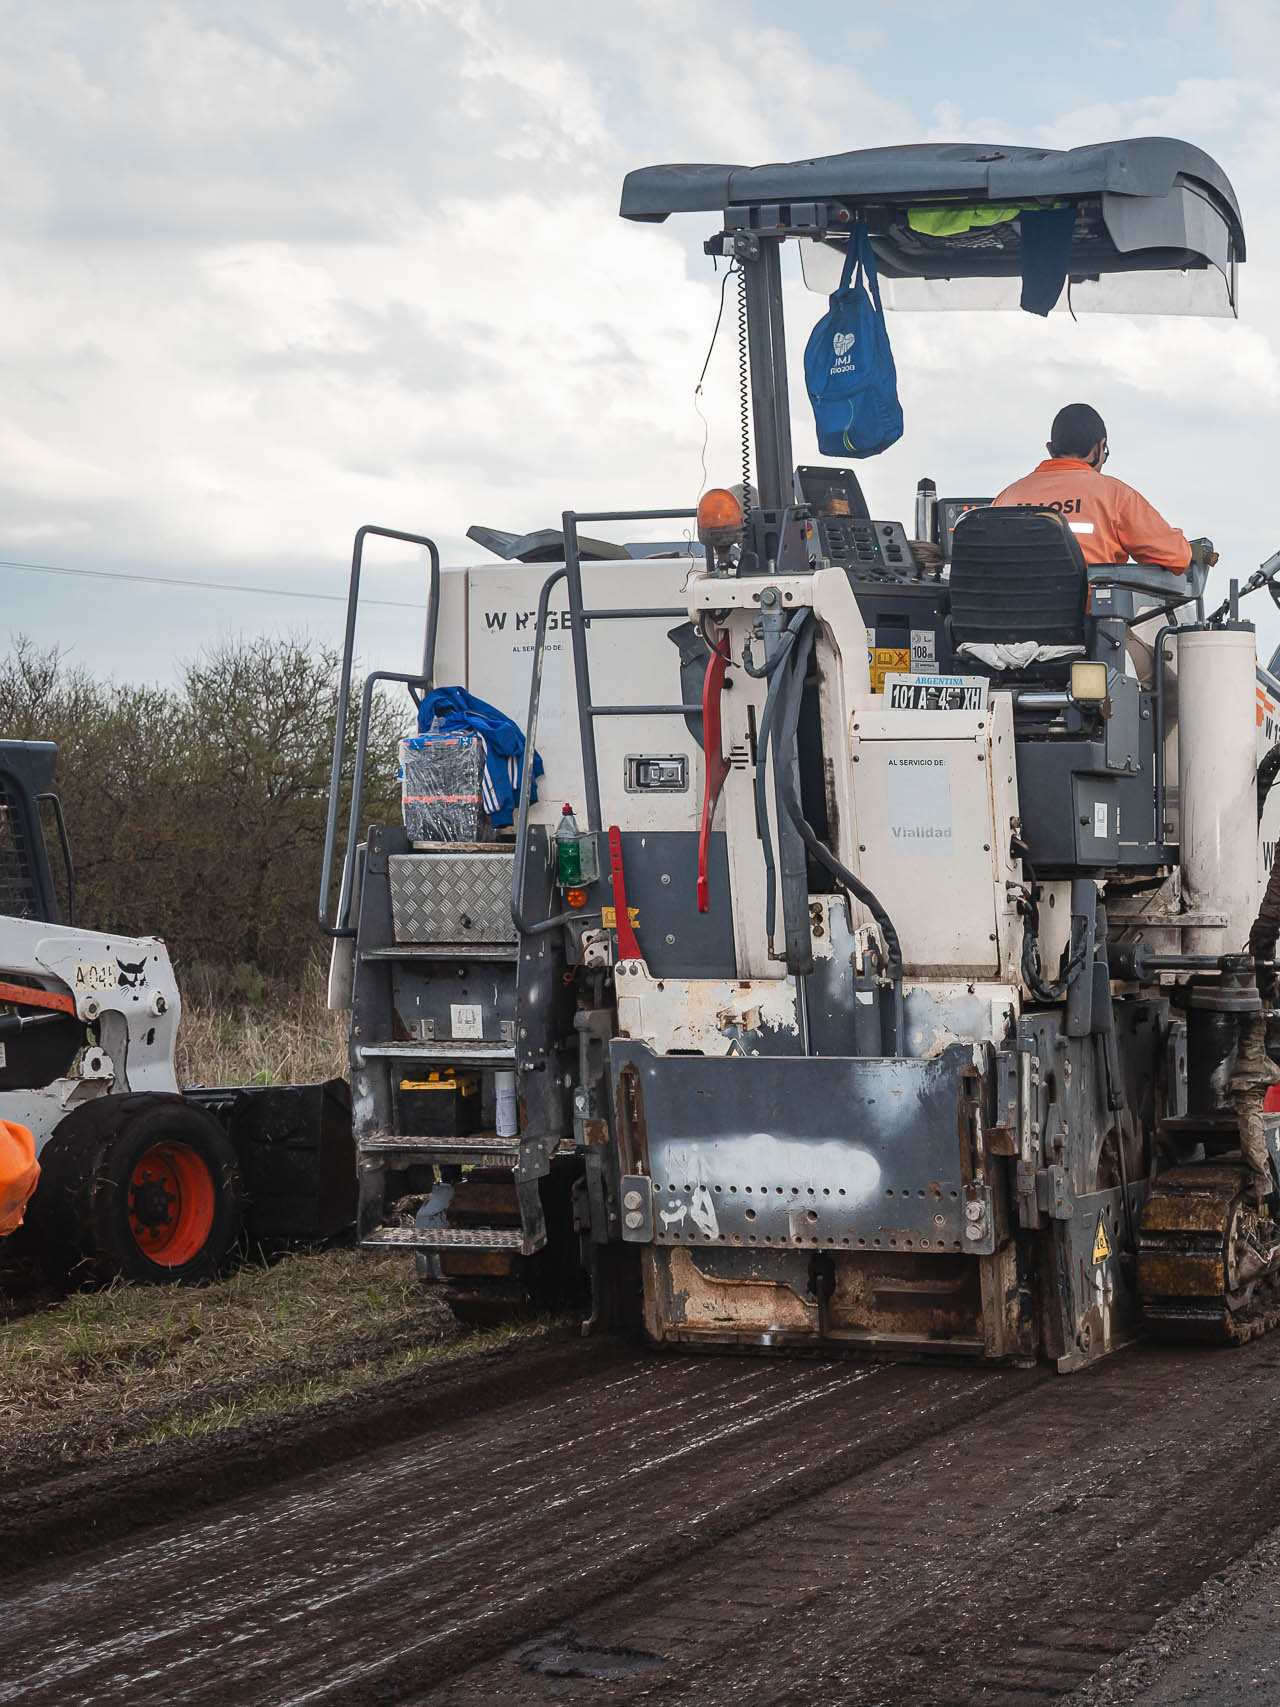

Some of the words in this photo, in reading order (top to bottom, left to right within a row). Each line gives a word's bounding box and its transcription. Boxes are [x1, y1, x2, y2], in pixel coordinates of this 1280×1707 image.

[834, 355, 851, 367] JMJ
[1039, 498, 1081, 514] OSI
[523, 645, 552, 653] SERIO
[912, 646, 927, 659] 108
[915, 677, 963, 686] ARGENTINA
[893, 686, 915, 709] 101
[918, 686, 936, 710] A
[963, 688, 981, 710] XH
[1265, 716, 1274, 740] W
[892, 827, 952, 838] Vialidad
